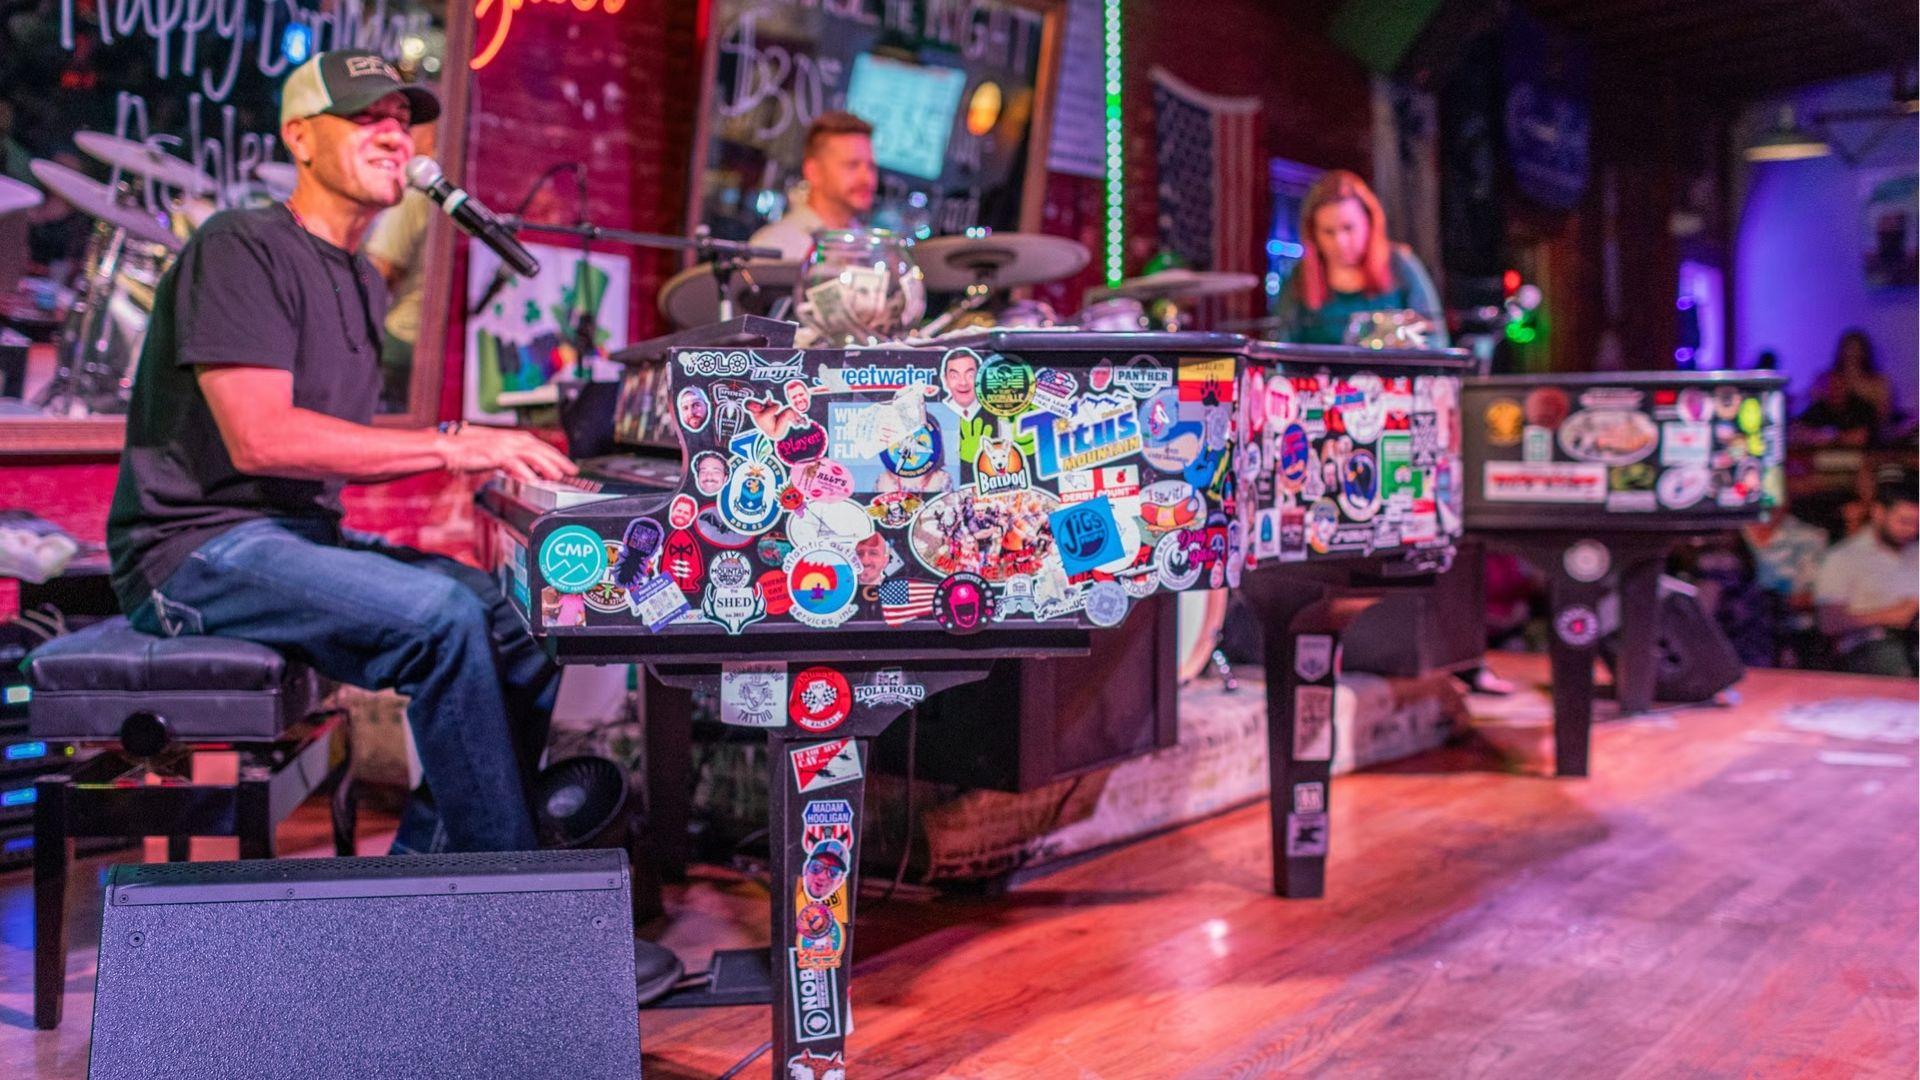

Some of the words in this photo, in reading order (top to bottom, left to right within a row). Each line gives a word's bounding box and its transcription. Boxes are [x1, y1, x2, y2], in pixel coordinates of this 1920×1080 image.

[1117, 370, 1168, 381] PANTHER
[1063, 437, 1140, 471] MOUNTAIN
[555, 543, 593, 558] CMP
[784, 541, 823, 572] atlantic
[717, 597, 751, 608] SHED
[857, 686, 888, 699] TOLL
[889, 685, 923, 699] ROAD
[812, 803, 844, 813] MADAM
[807, 813, 849, 824] HOOLIGAN
